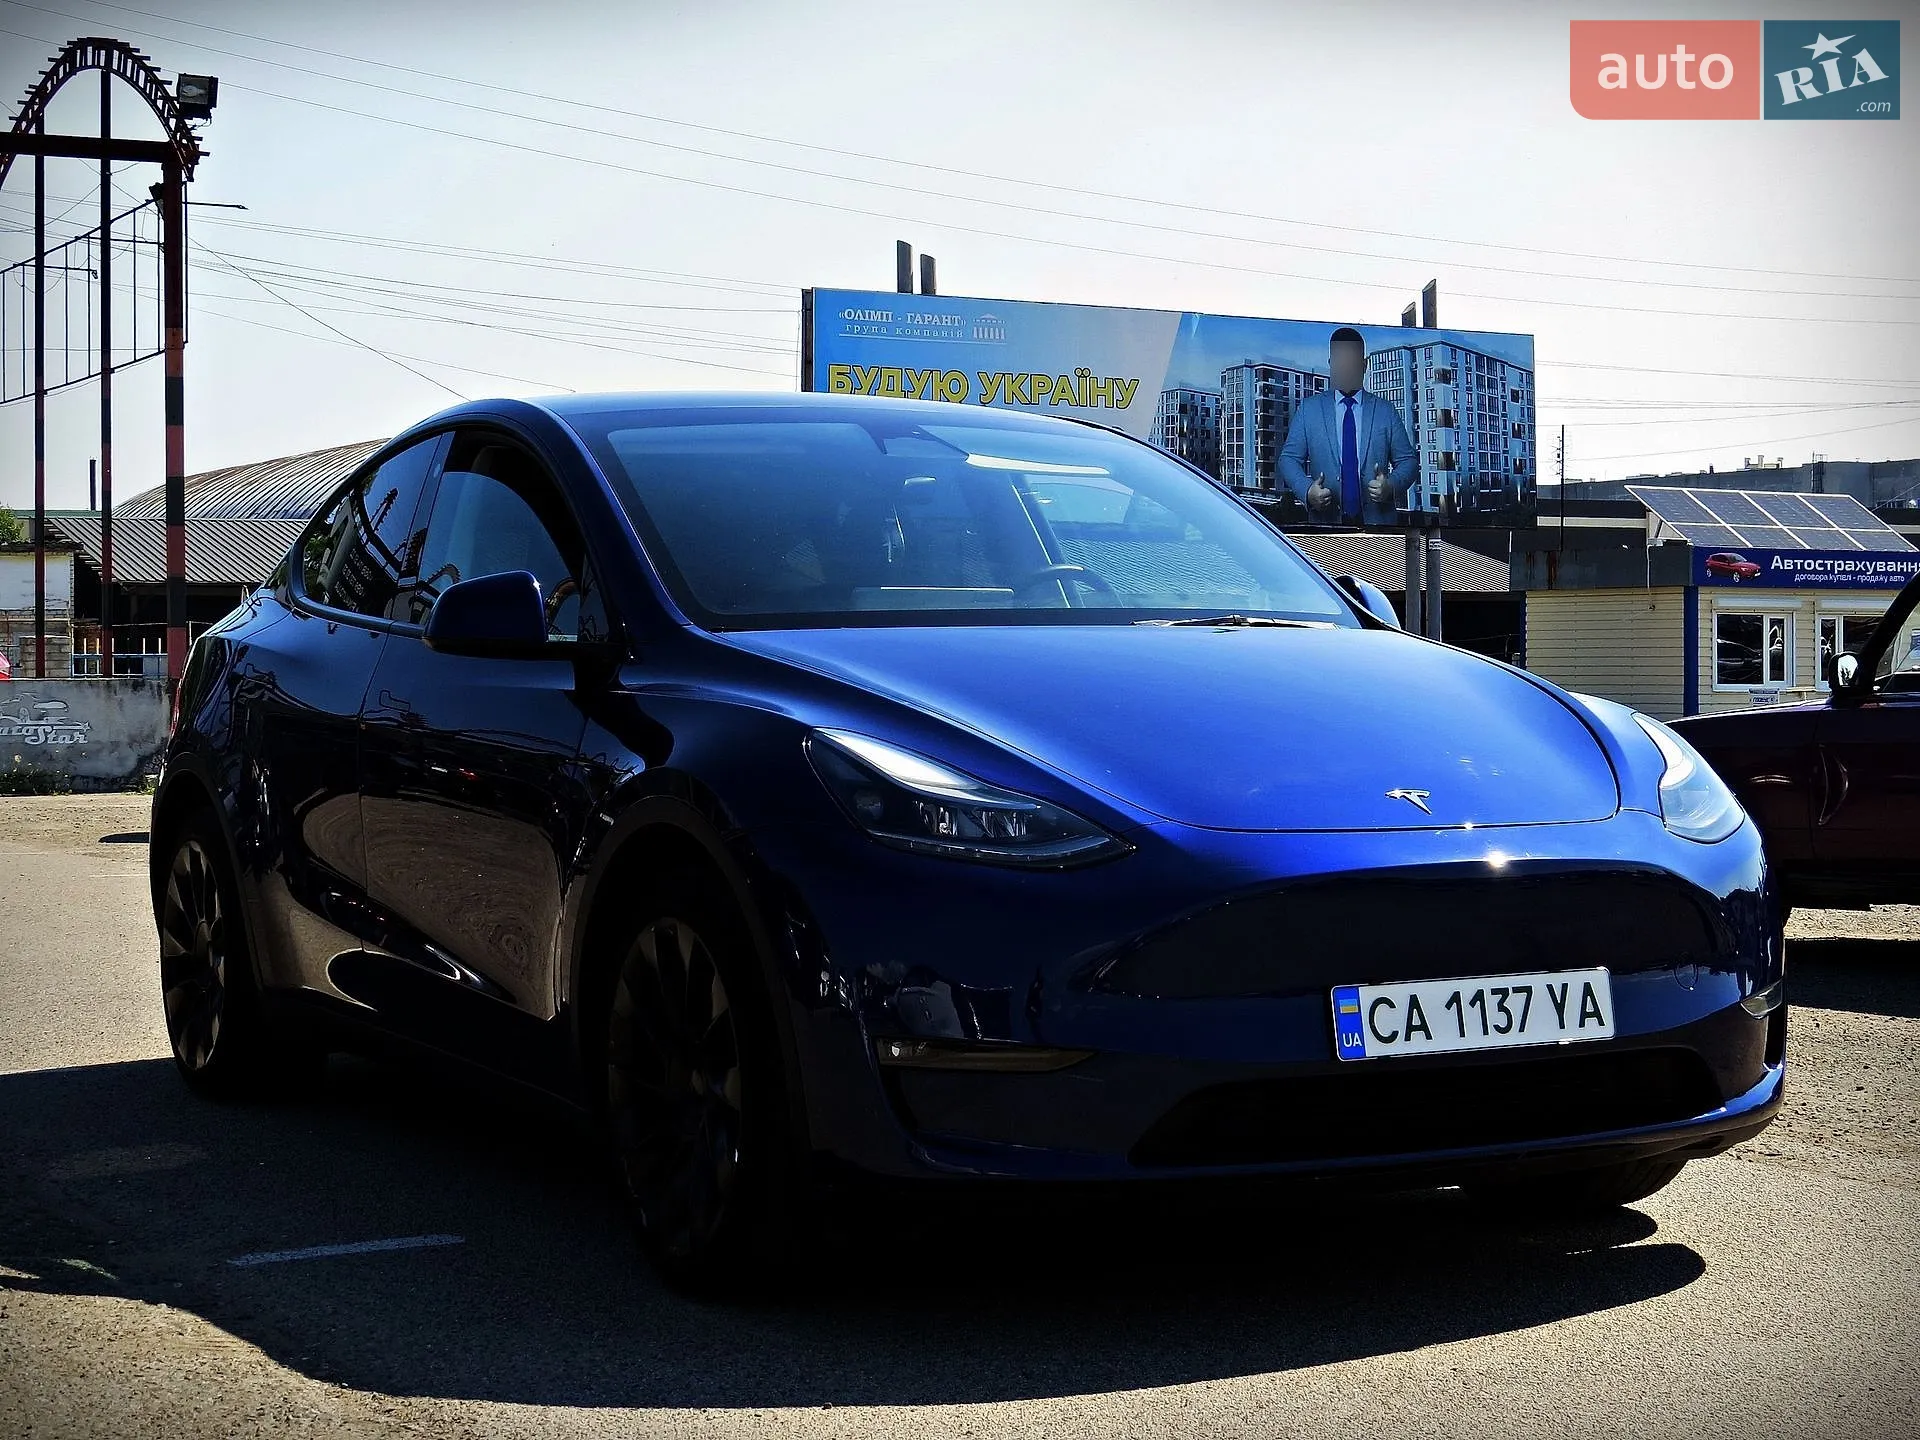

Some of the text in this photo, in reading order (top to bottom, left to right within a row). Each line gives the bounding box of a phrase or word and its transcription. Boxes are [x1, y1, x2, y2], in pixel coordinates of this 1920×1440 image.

[845, 324, 964, 338] група компаній
[828, 364, 1141, 410] БУДУЮ УКРАЇНУ
[1342, 981, 1606, 1048] UA CA 1137 YA
